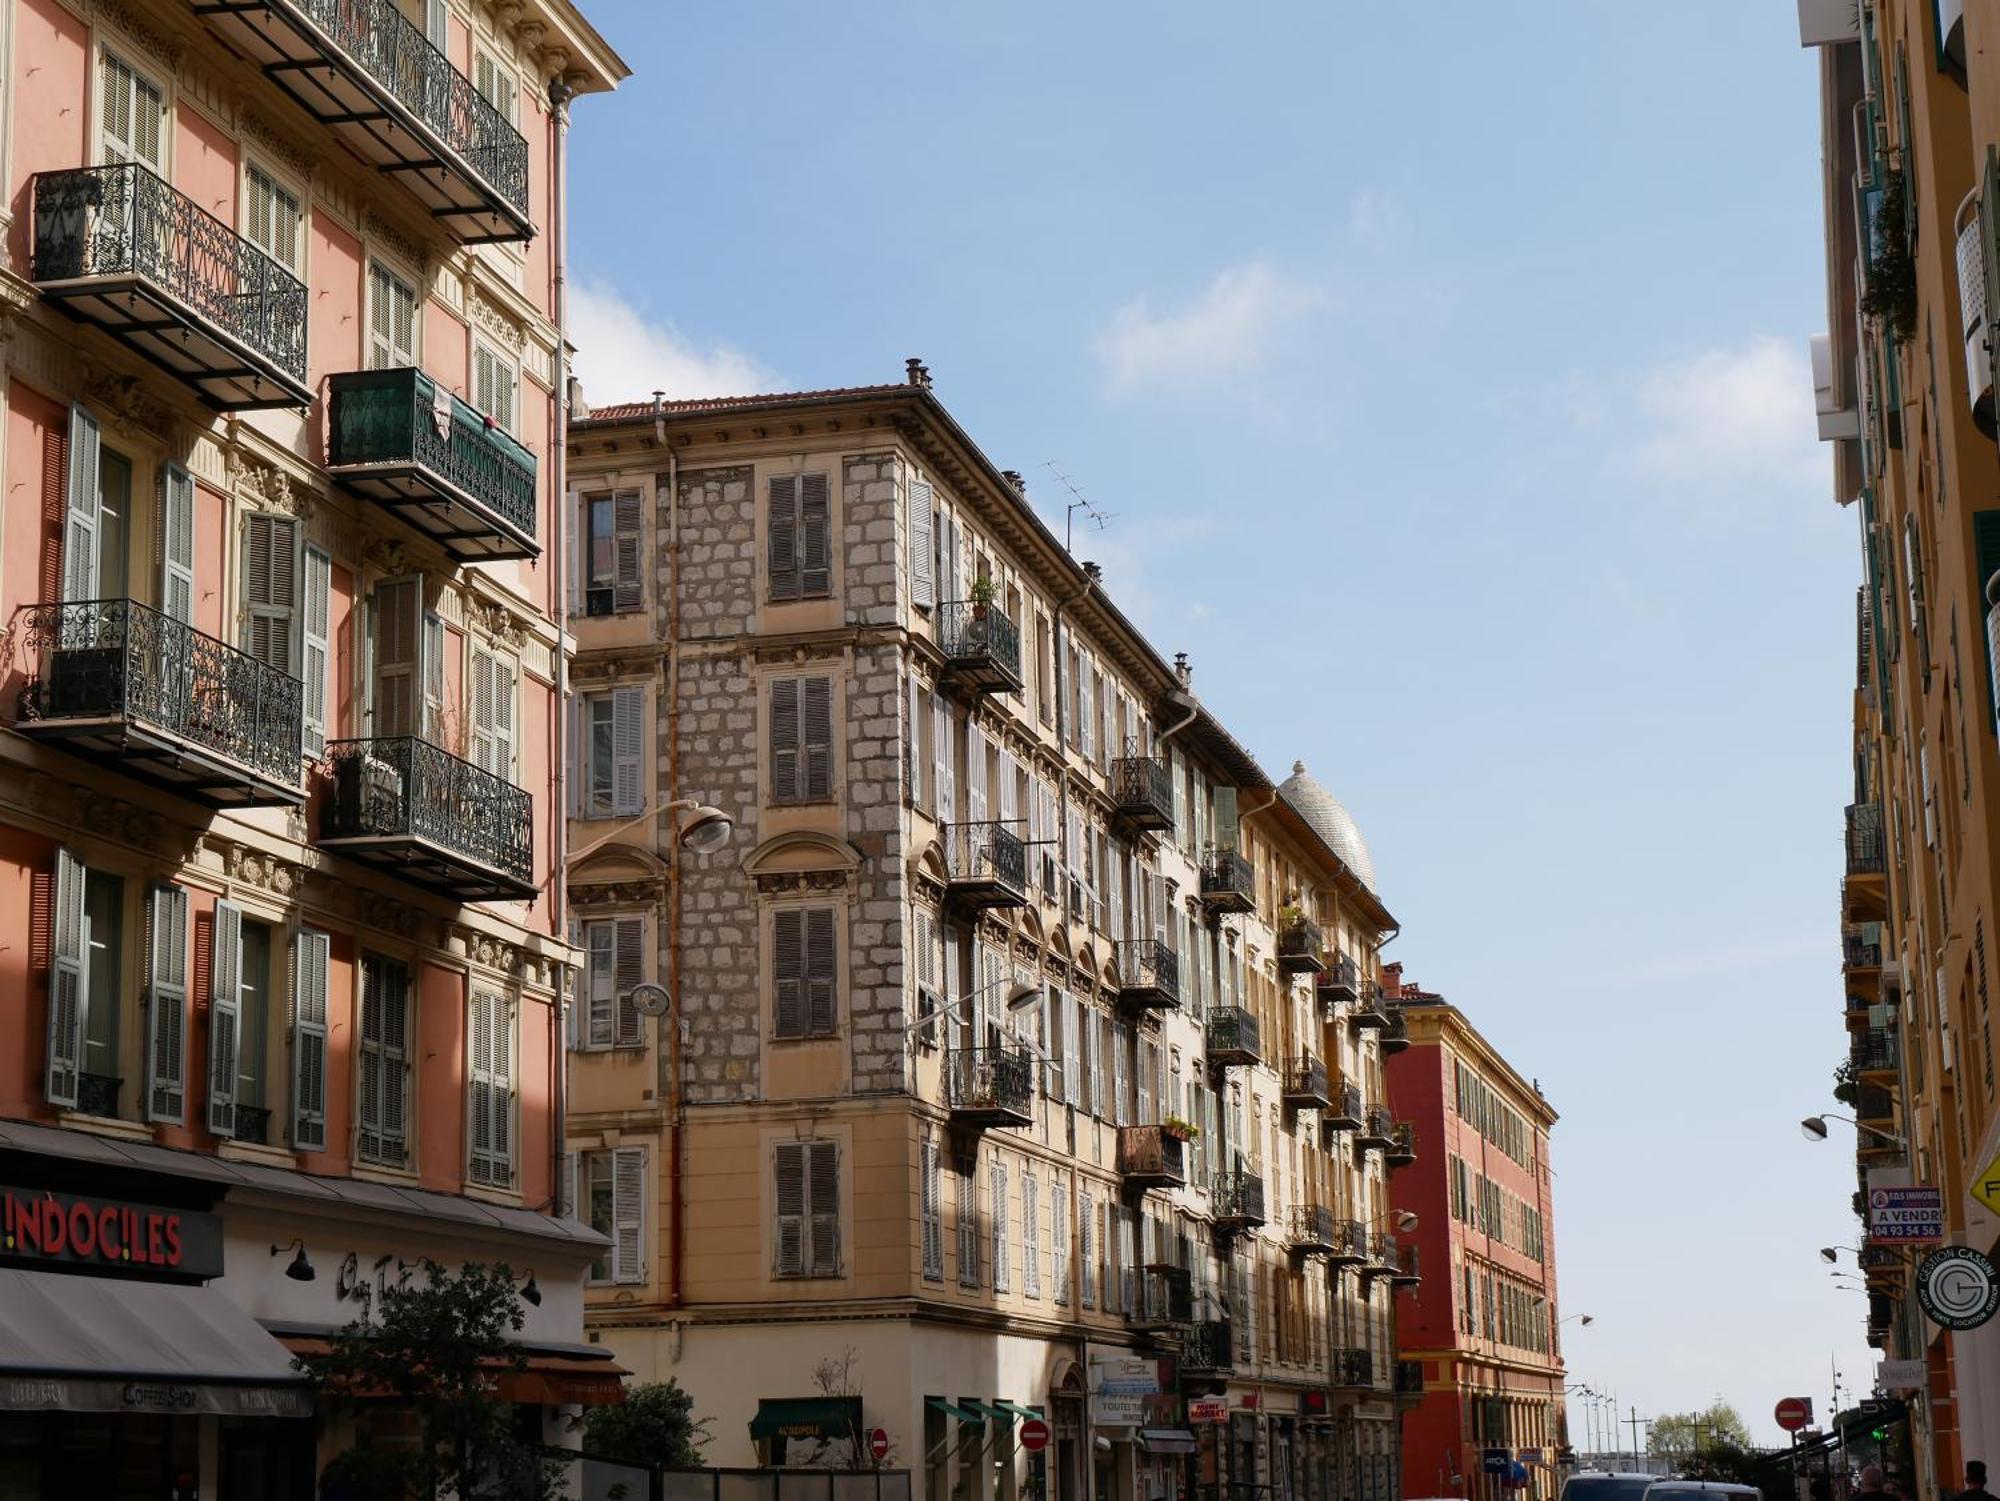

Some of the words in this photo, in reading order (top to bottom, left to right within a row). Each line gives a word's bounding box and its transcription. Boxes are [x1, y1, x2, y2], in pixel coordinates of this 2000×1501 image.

[1879, 1211, 1888, 1221] A
[1874, 1225, 1888, 1236] 04
[1890, 1225, 1904, 1236] 93
[1905, 1225, 1919, 1236] 54
[1921, 1225, 1936, 1236] 56
[1919, 1249, 1955, 1282] GESTION
[1957, 1248, 1996, 1278] CASSINI
